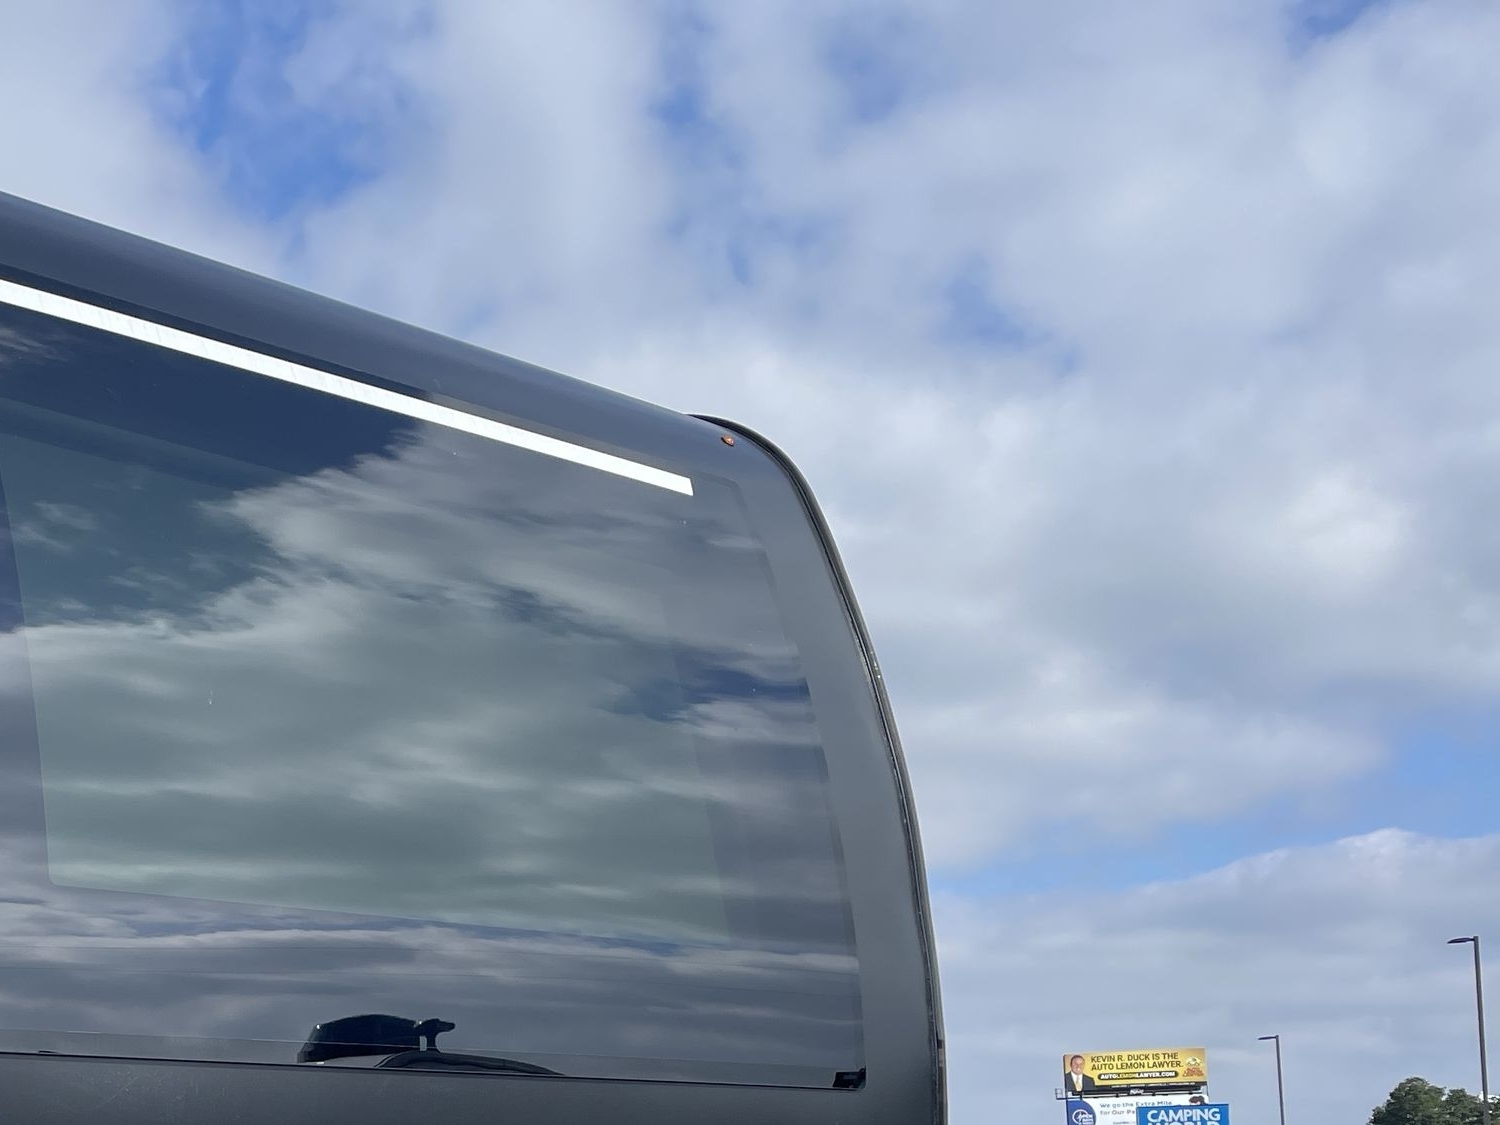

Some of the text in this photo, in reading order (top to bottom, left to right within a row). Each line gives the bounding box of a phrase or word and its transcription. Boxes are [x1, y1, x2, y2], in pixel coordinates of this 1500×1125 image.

[1128, 1053, 1150, 1061] DUCK
[1162, 1052, 1178, 1060] THE
[1147, 1060, 1184, 1068] LAWYER.
[1147, 1108, 1221, 1122] CAMPING
